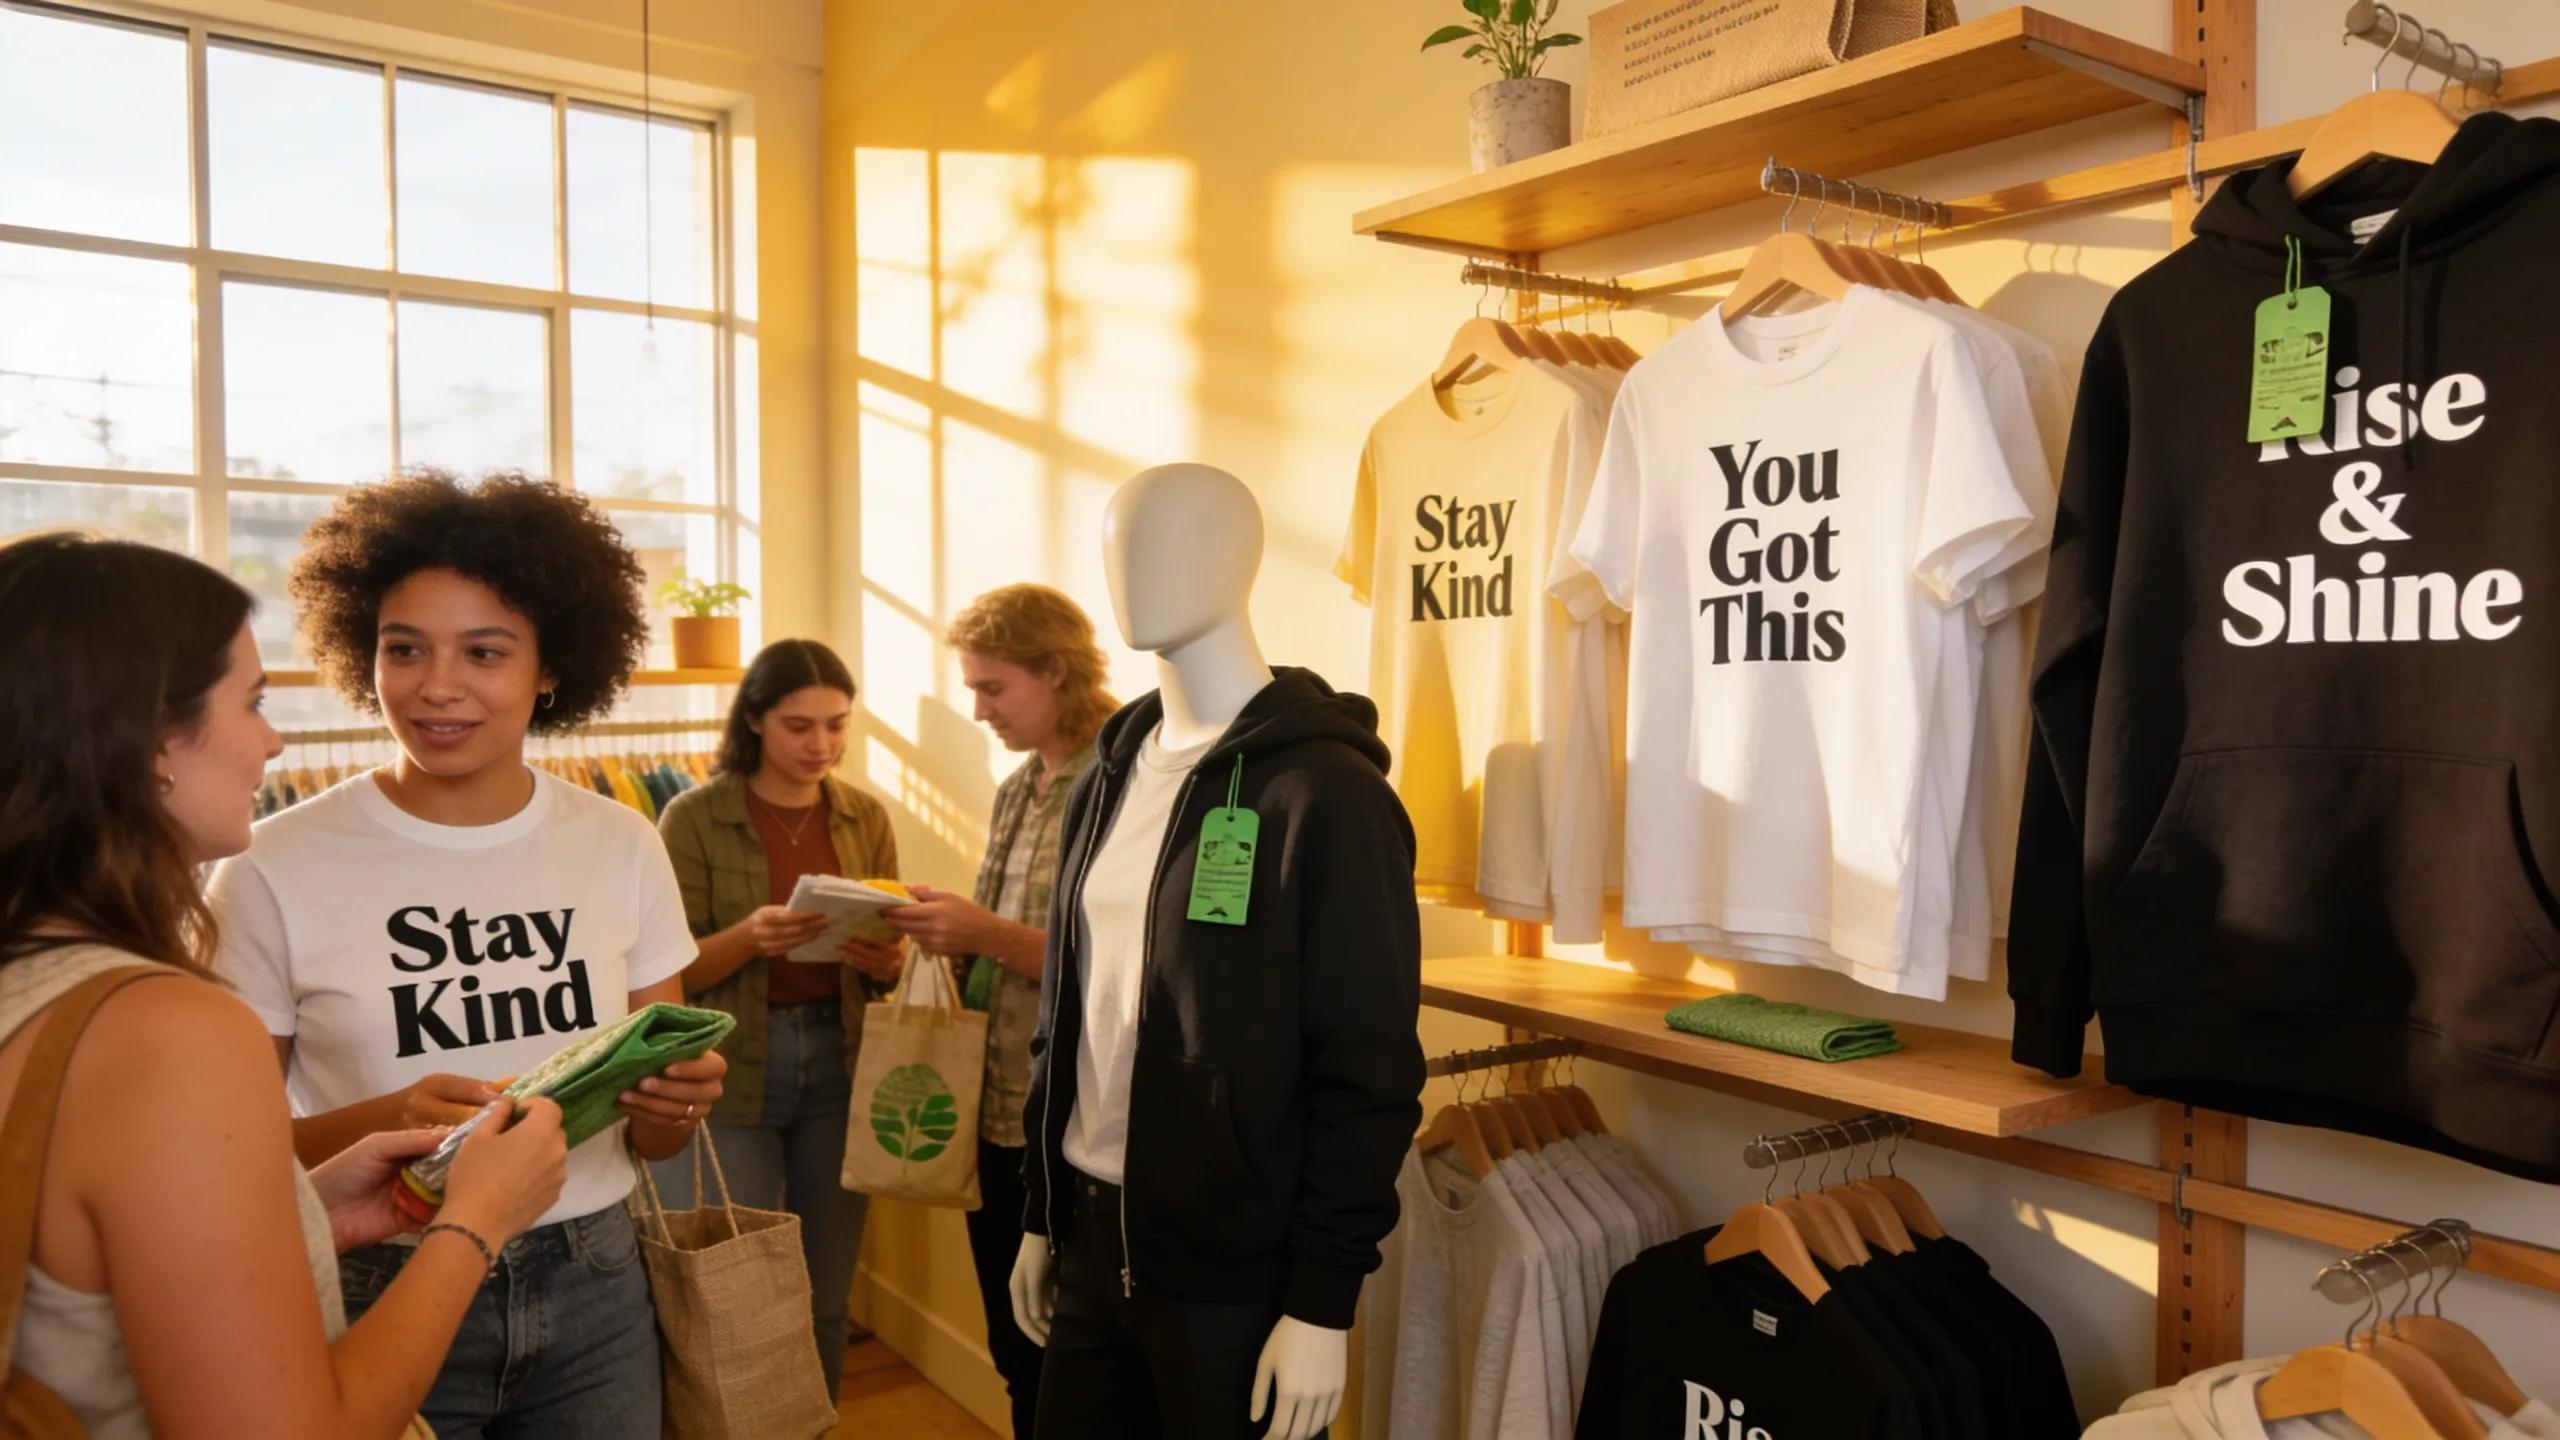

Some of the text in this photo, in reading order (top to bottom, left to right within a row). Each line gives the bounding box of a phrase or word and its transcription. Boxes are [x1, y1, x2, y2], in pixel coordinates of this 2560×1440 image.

[2258, 367, 2486, 462] ise
[1709, 439, 1840, 510] You
[2319, 461, 2412, 545] &
[1415, 494, 1517, 561] Stay
[1709, 515, 1840, 587] Got
[1410, 555, 1513, 622] Kind
[2222, 551, 2524, 647] Shine
[1700, 591, 1846, 665] This
[387, 906, 575, 973] Stay
[388, 959, 597, 1058] Kind
